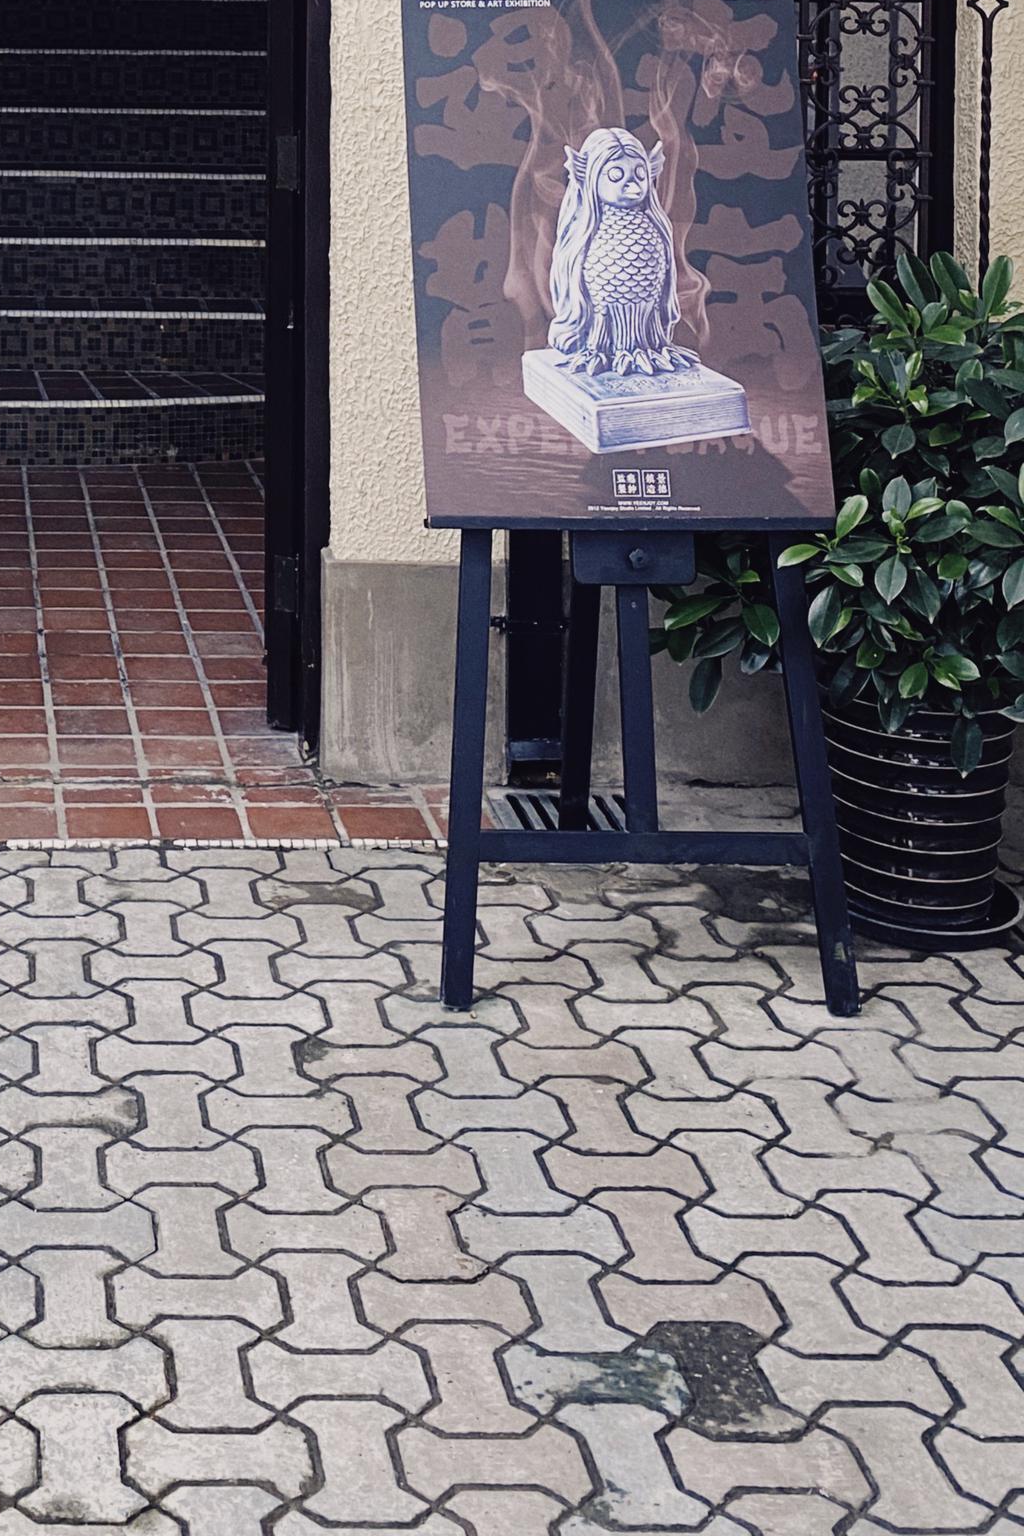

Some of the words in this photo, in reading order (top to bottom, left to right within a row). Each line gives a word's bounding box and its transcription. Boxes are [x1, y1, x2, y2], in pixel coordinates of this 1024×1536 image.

[419, 0, 436, 9] POP
[438, 0, 449, 9] UP
[451, 0, 476, 8] STORE
[478, 0, 486, 8] &
[487, 0, 502, 8] ART
[505, 0, 551, 8] EXHIBITION
[442, 413, 598, 456] EXPE
